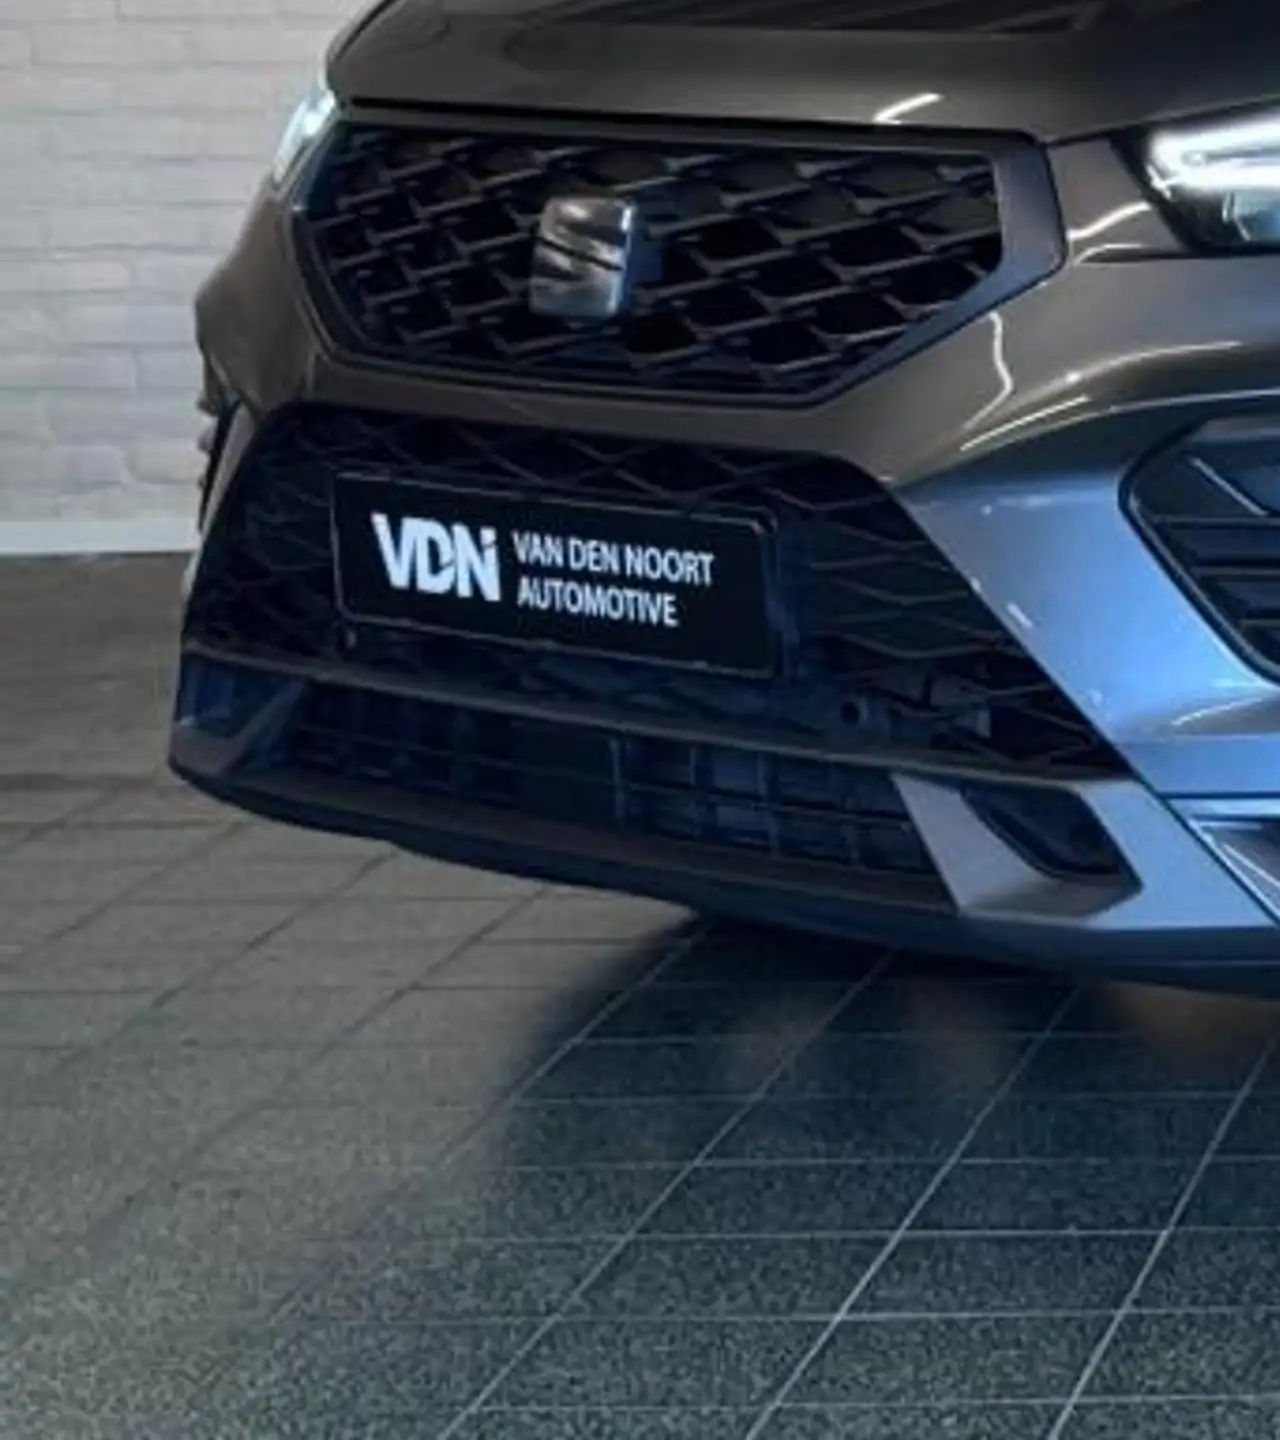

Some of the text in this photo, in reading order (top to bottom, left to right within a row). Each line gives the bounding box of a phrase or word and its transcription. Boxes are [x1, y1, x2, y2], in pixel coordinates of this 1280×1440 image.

[371, 512, 502, 603] VDN
[513, 531, 715, 586] VAN DEN NOORT
[517, 575, 679, 627] AUTOMOTIVE
